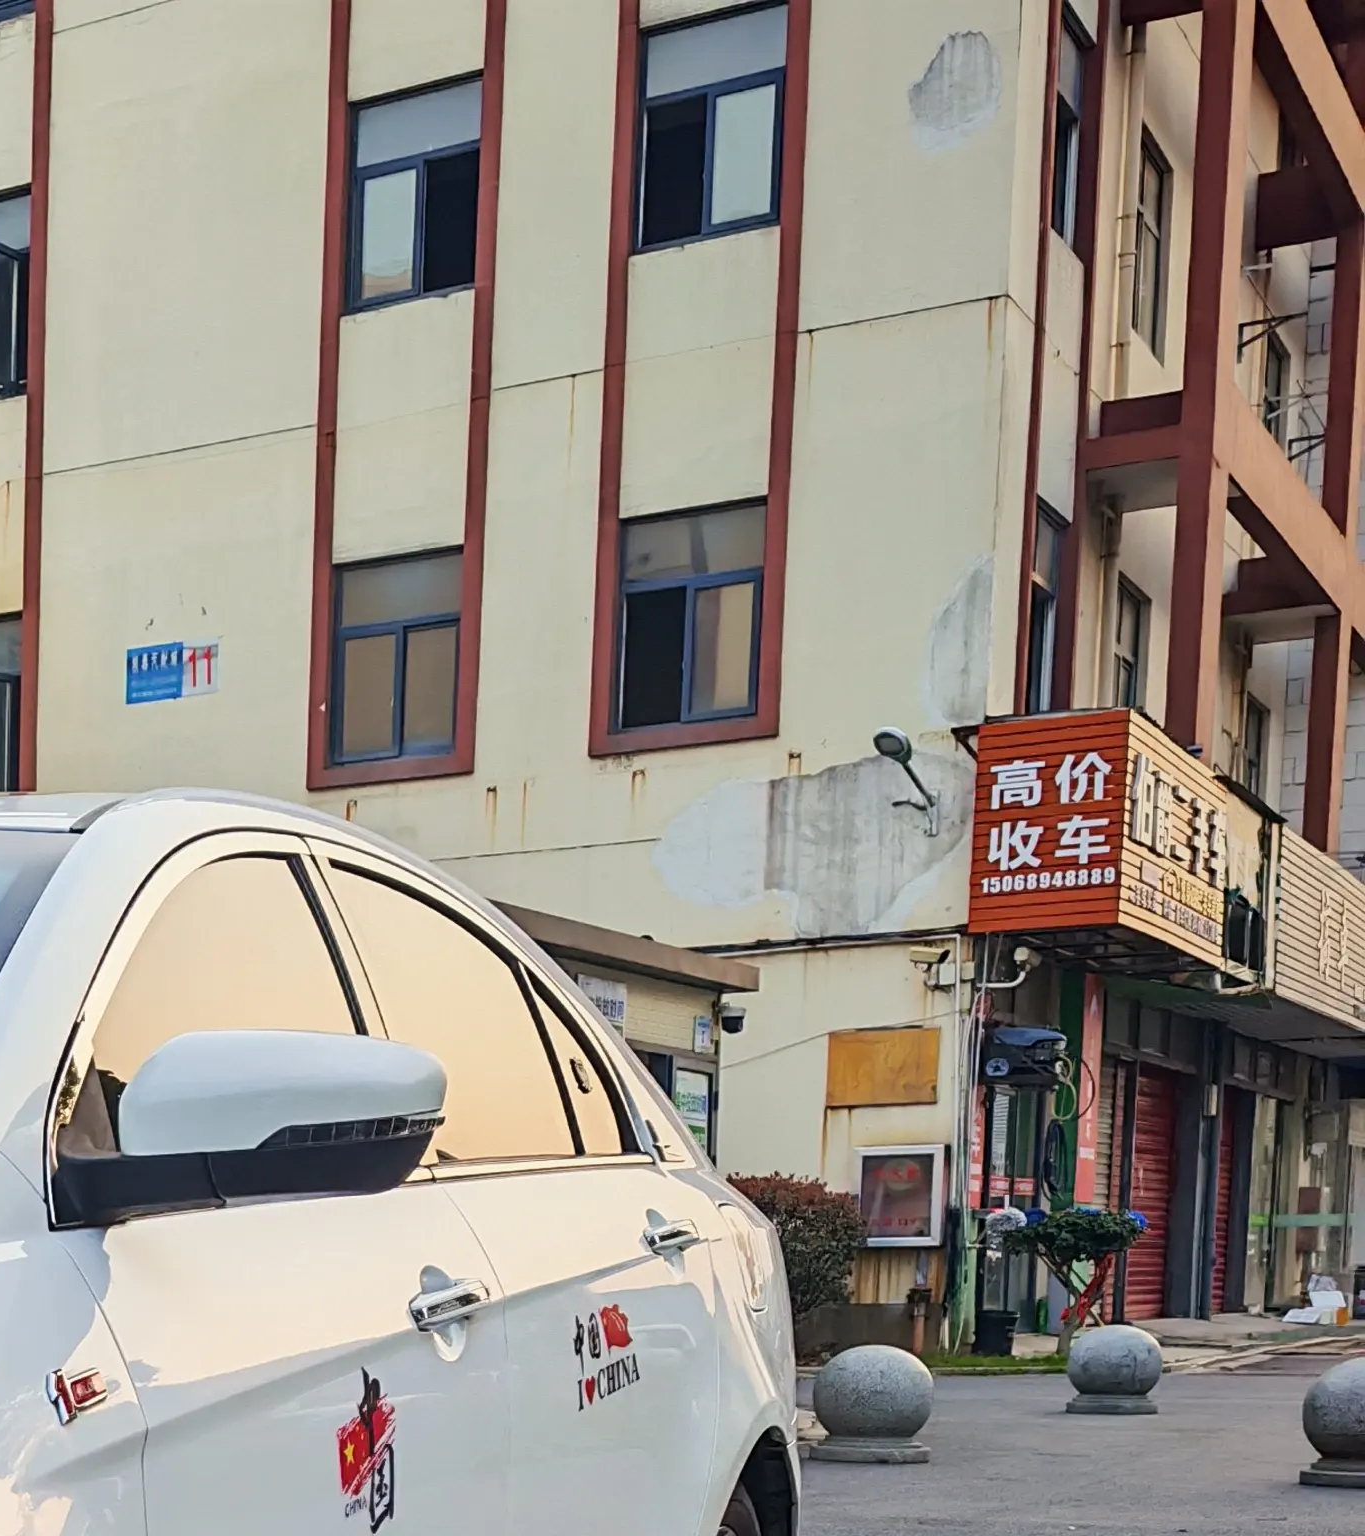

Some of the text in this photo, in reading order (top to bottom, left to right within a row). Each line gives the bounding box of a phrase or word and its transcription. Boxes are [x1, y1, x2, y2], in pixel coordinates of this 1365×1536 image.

[188, 645, 212, 688] 11
[988, 751, 1113, 810] 高价
[987, 815, 1111, 871] 收车
[980, 866, 1116, 894] 15068948889
[597, 1353, 640, 1400] CHINA
[344, 1496, 368, 1519] CHINA
